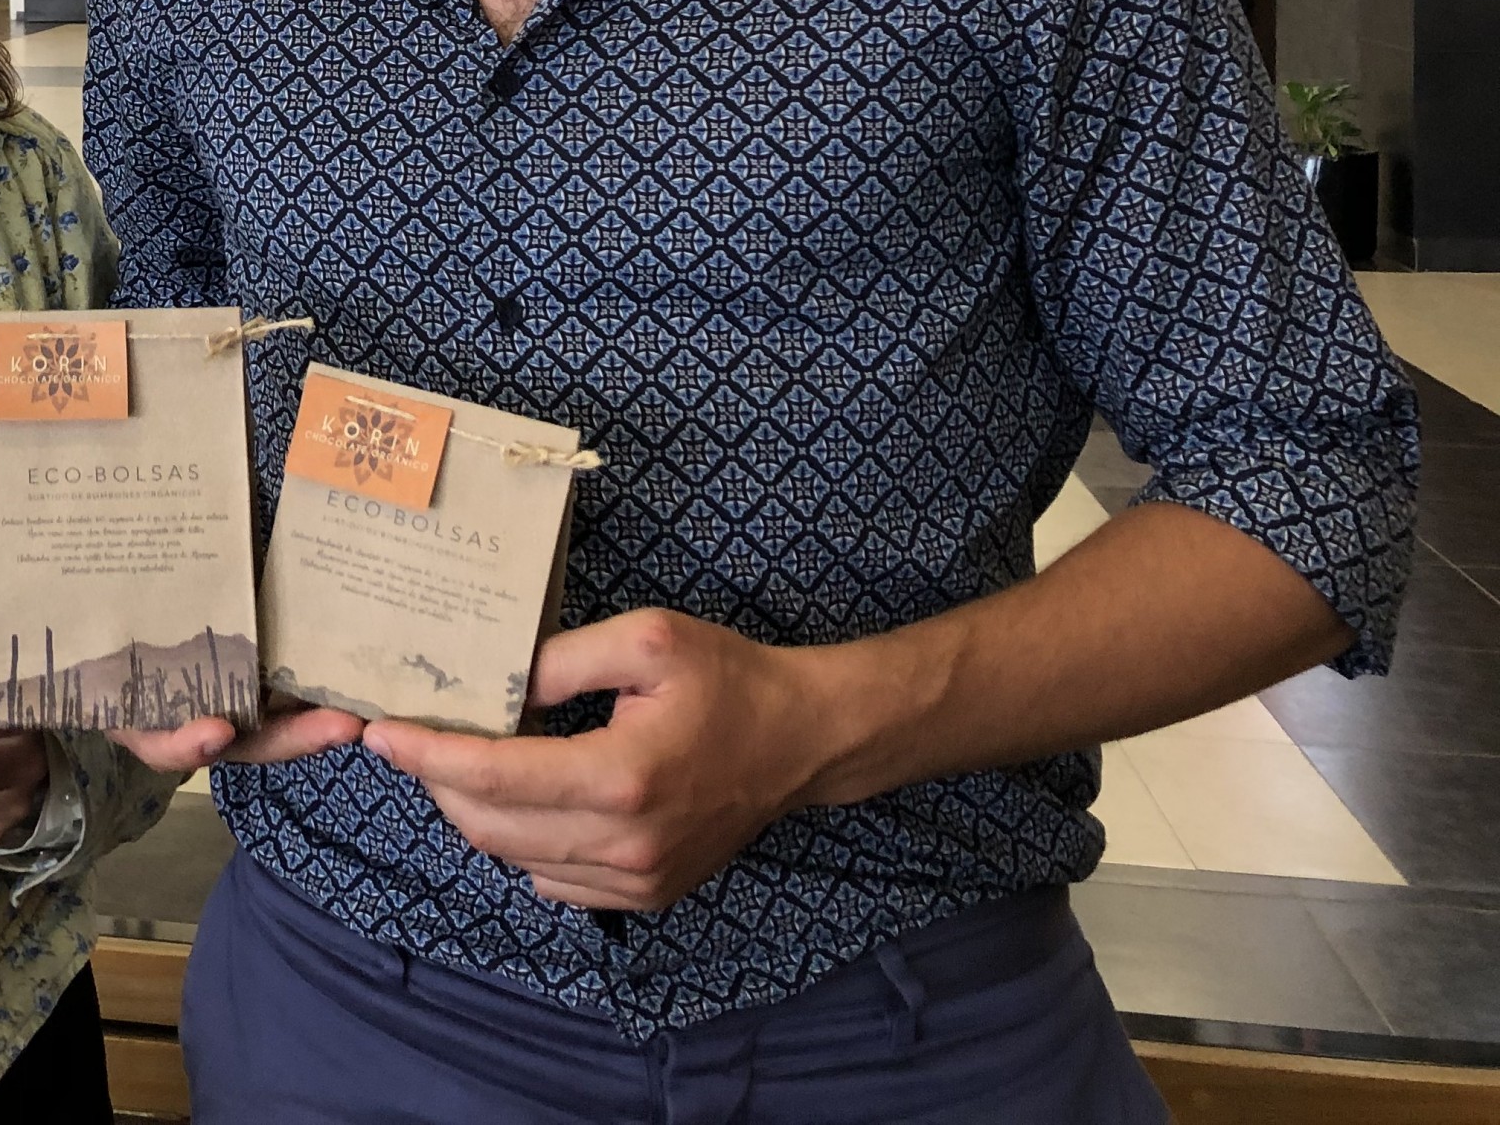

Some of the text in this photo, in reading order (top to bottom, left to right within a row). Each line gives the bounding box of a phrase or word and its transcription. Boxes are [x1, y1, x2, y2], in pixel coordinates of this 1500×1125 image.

[10, 355, 107, 372] KORIN
[304, 430, 367, 455] CHOCOLATE
[321, 414, 420, 456] KORIN
[28, 463, 199, 484] ECO-BOLSAS
